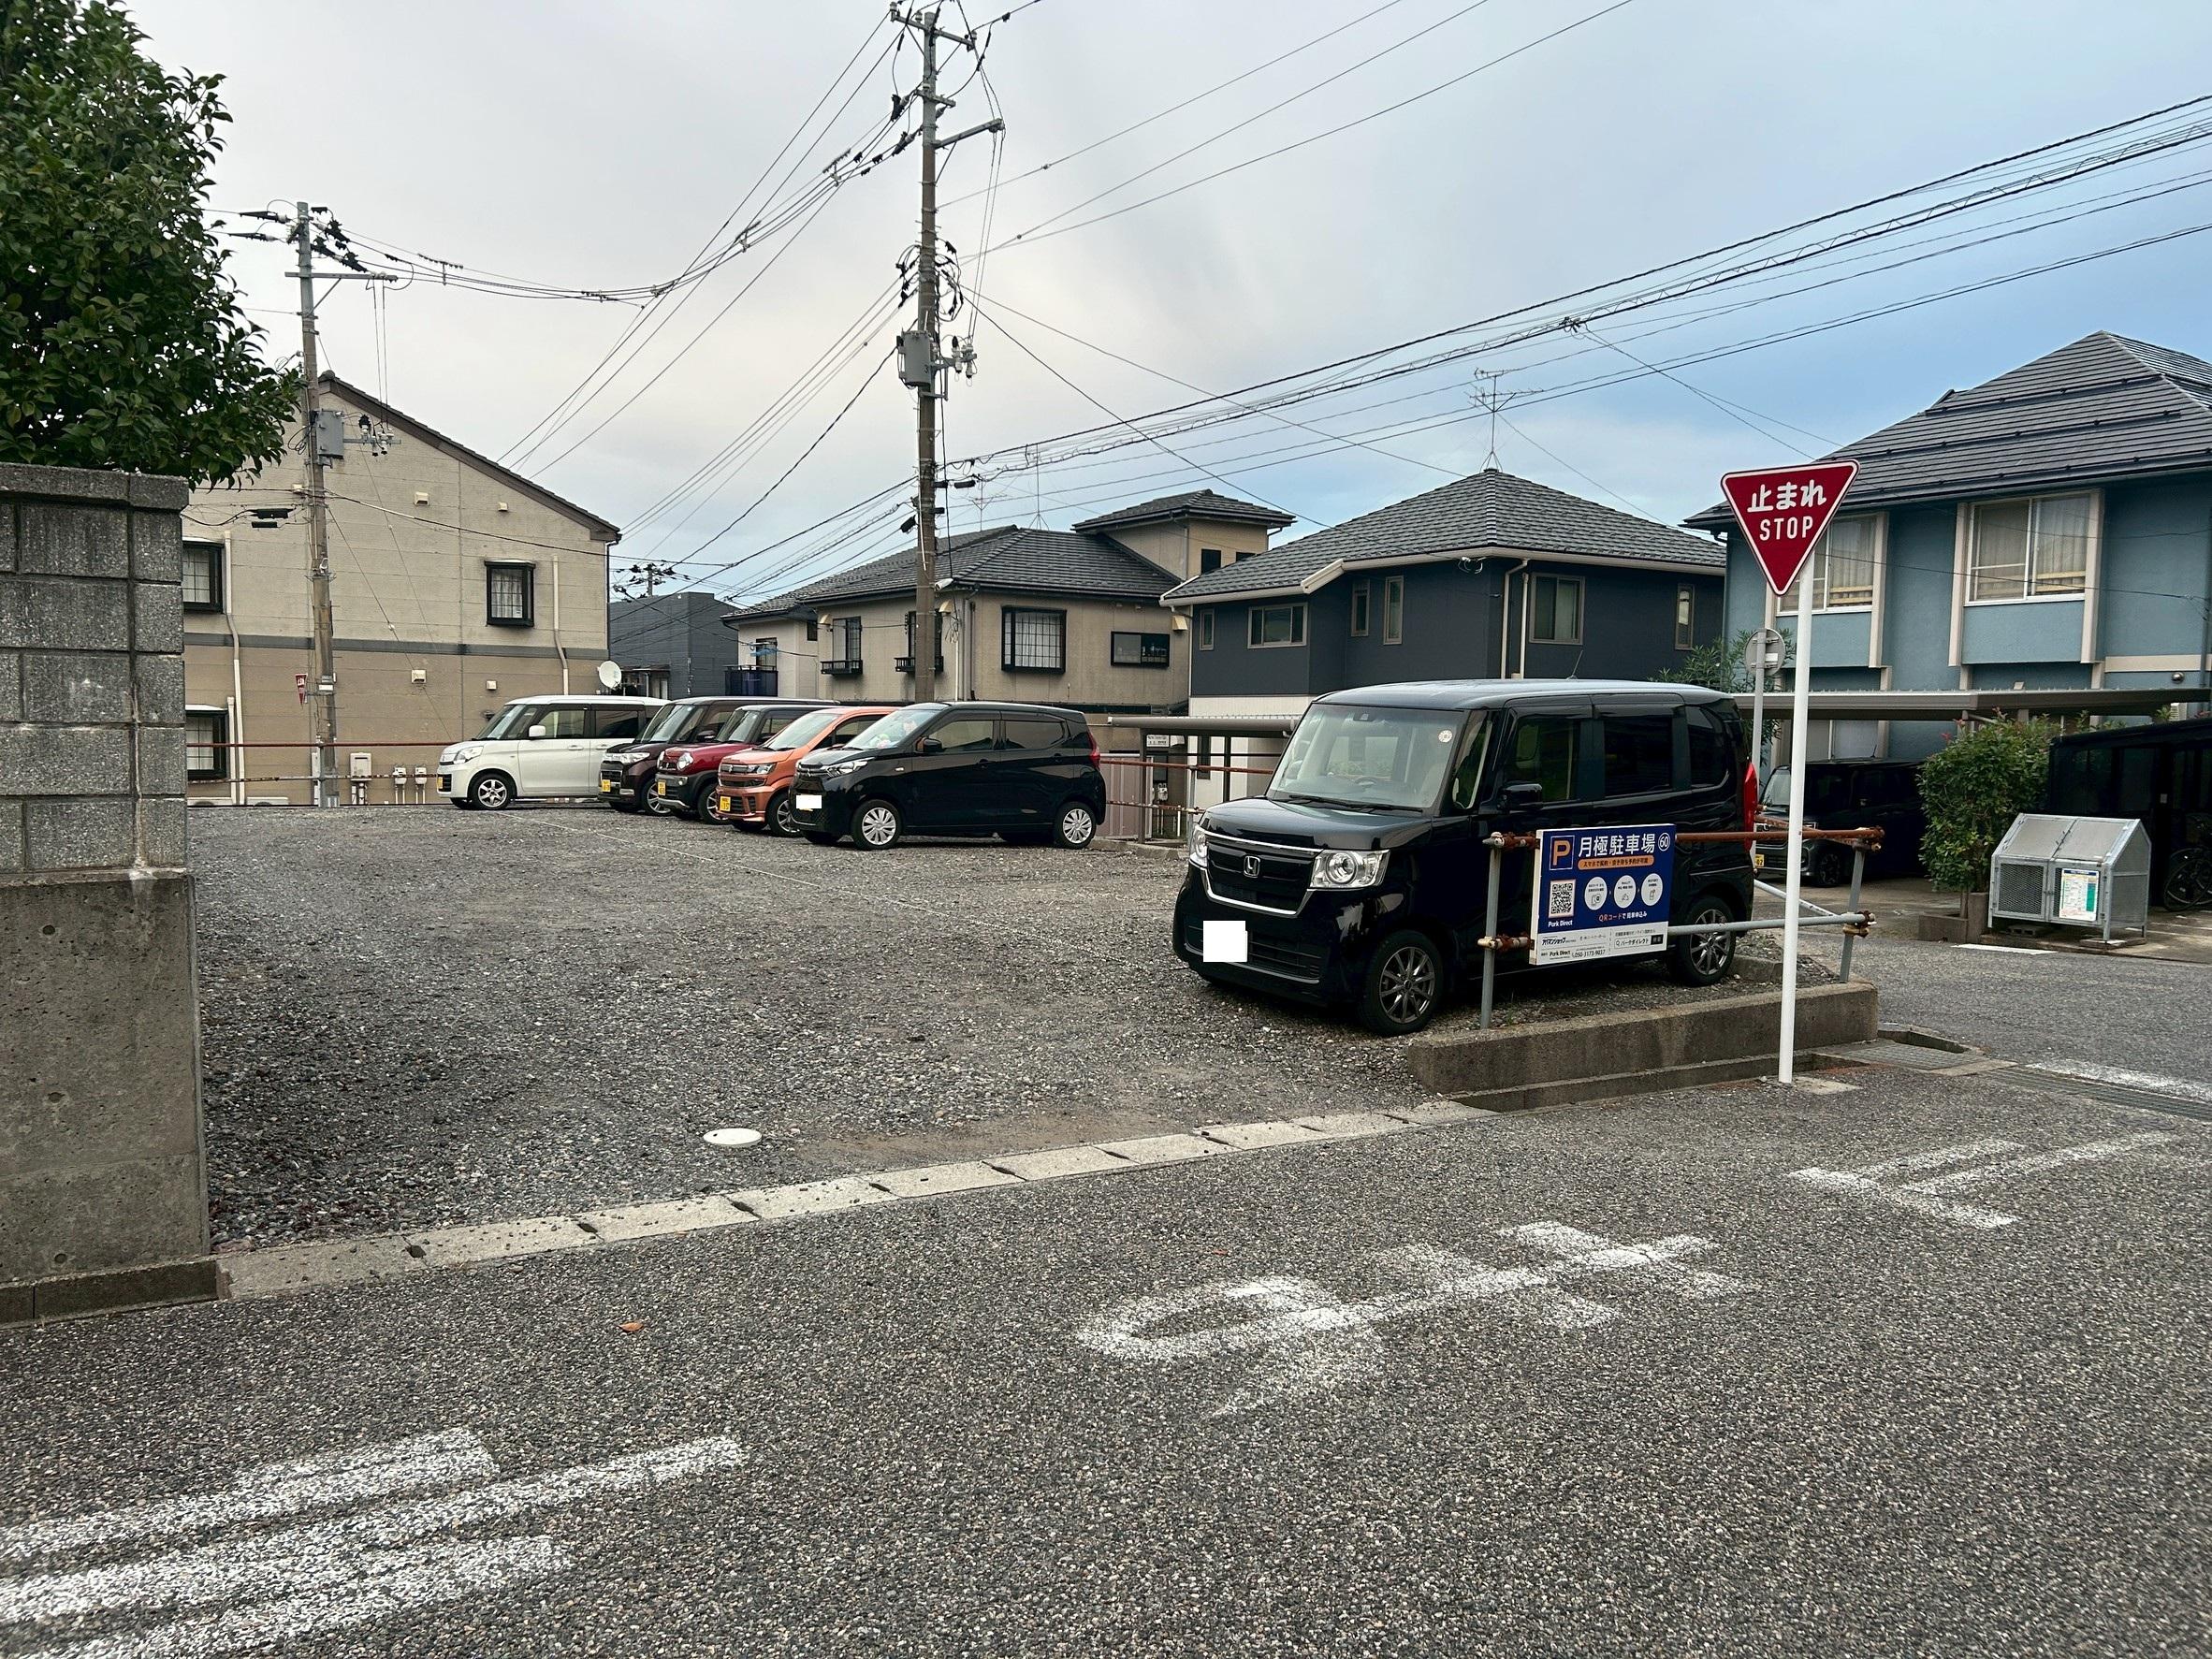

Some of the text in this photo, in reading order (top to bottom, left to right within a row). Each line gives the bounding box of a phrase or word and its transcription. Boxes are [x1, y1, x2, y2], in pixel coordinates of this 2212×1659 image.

[1747, 479, 1826, 513] 止まれ
[1760, 515, 1813, 541] STOP
[1552, 840, 1571, 866] P
[1578, 833, 1655, 858] 月極駐車場
[1560, 919, 1573, 927] Direct
